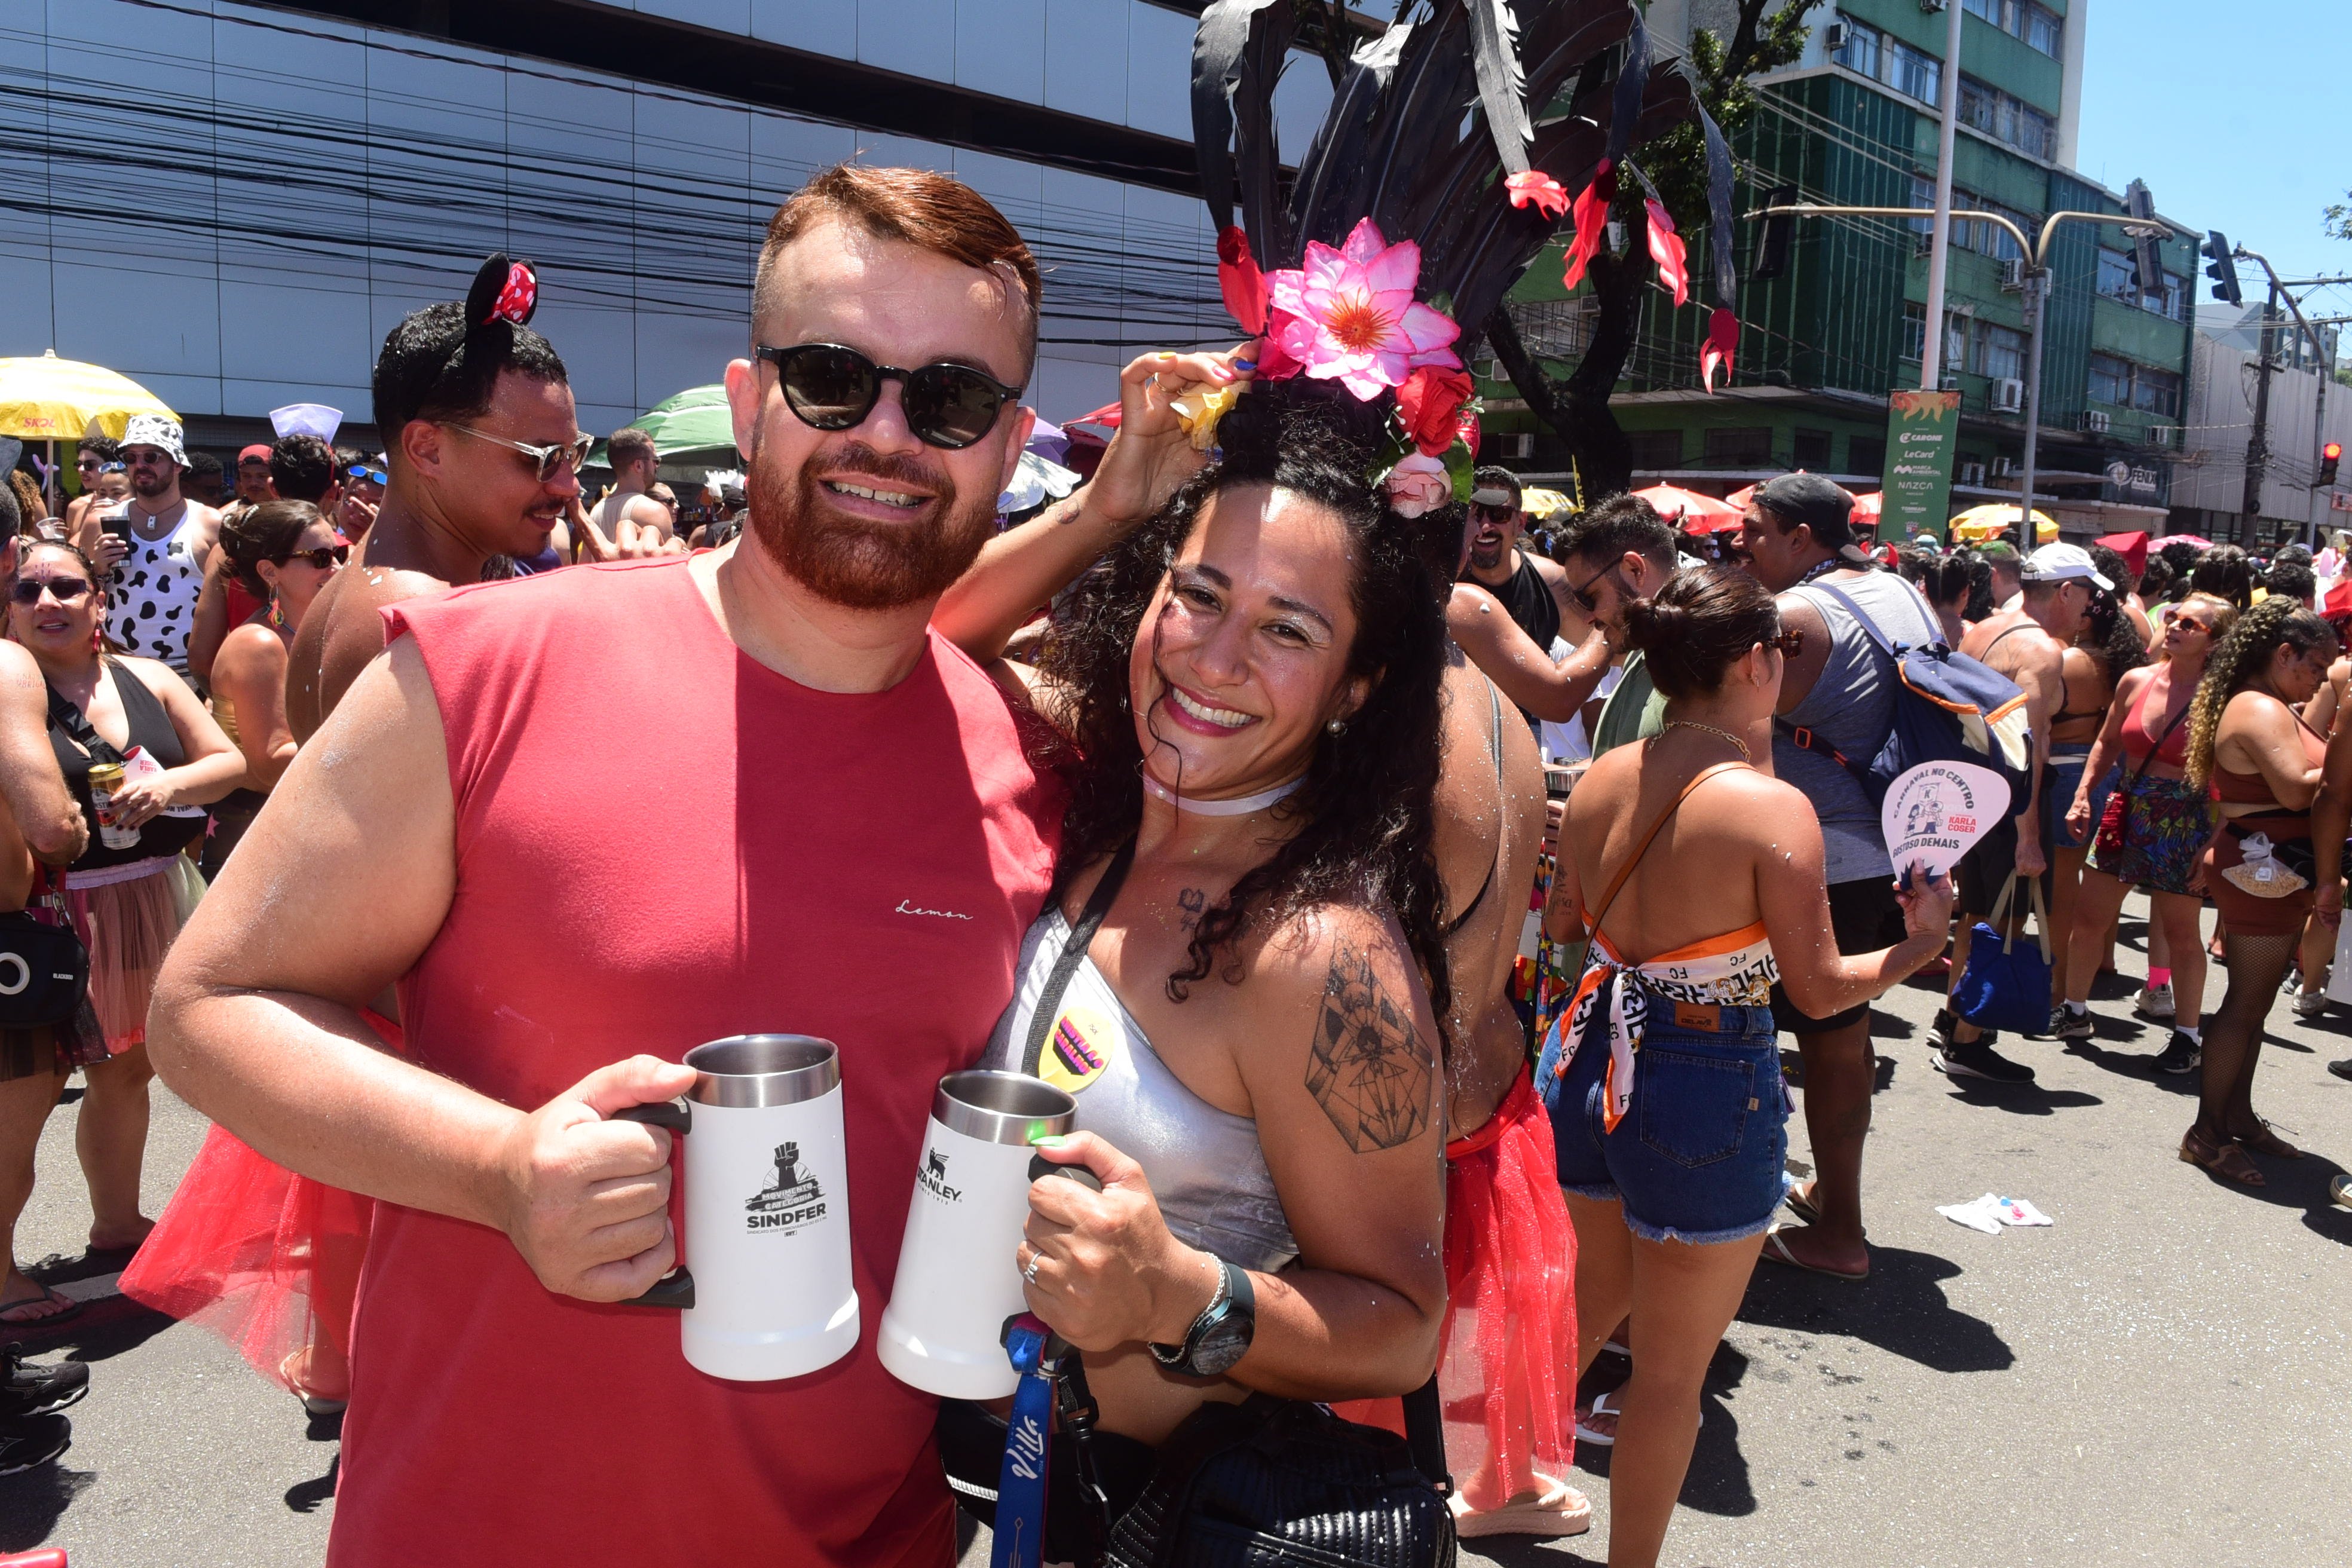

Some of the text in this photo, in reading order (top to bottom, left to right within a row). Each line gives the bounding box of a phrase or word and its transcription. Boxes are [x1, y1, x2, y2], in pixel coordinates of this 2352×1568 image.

[24, 418, 56, 428] SKOL
[1898, 482, 1934, 490] NAZCA
[1946, 771, 1974, 810] CENTRO
[1947, 824, 1976, 834] COSER
[1949, 816, 1977, 826] KARLA
[1893, 837, 1960, 858] GOSTOSO DEMAIS
[896, 899, 974, 920] Lemon
[1729, 953, 1747, 966] FC
[1669, 967, 1689, 979] FC
[1561, 1045, 1576, 1061] FC
[761, 1182, 813, 1200] MOVIMENTO
[765, 1193, 814, 1210] CATEGORIA
[747, 1203, 826, 1229] SINDFER
